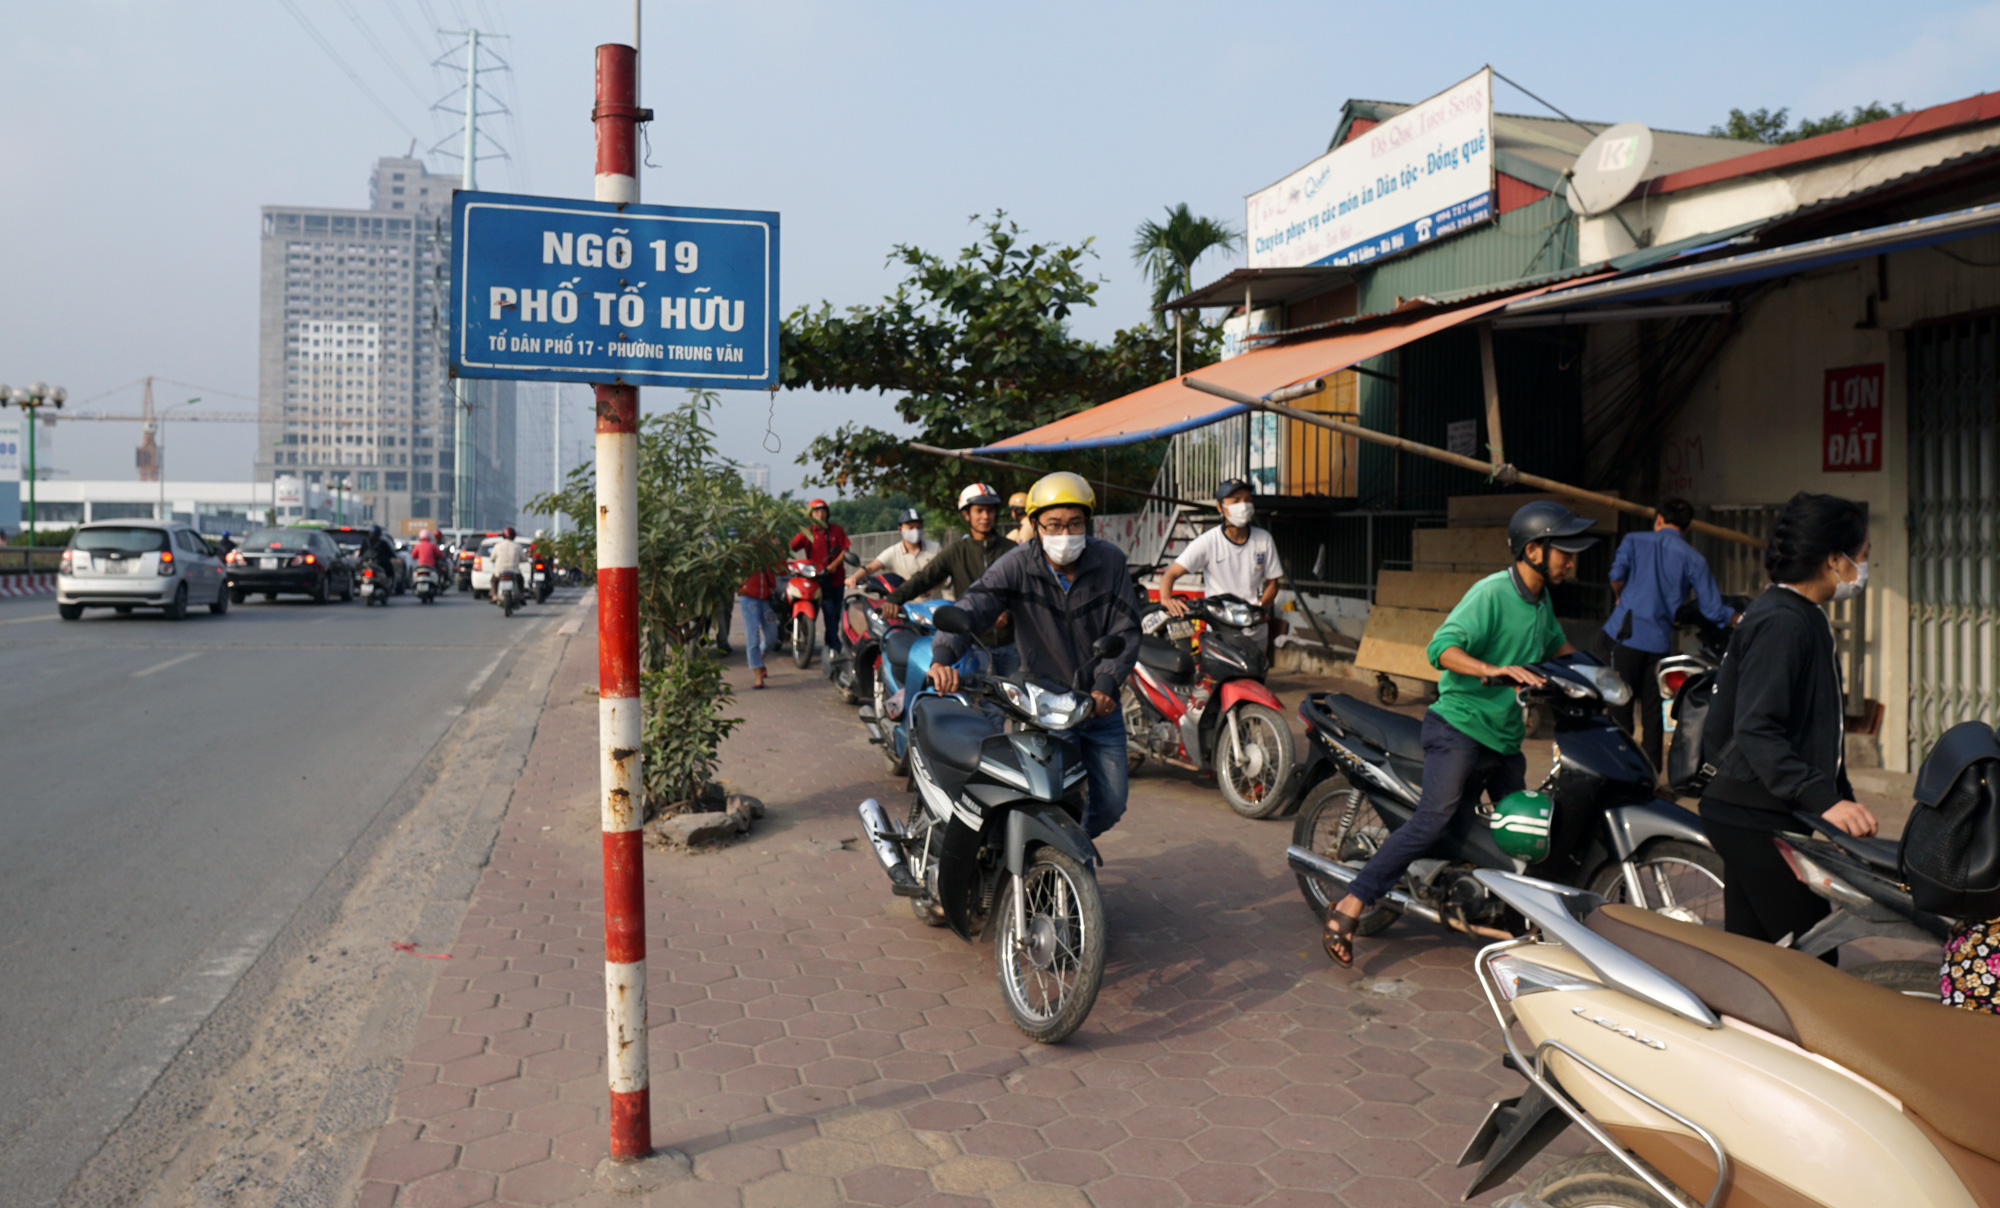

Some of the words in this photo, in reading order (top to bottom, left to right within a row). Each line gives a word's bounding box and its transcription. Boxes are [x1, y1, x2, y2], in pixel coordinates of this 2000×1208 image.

[1462, 128, 1486, 164] quê
[543, 228, 633, 269] NGÕ
[650, 240, 698, 274] 19
[490, 277, 581, 325] PHỐ
[594, 282, 647, 328] TỐ
[661, 287, 745, 332] HỮU
[489, 328, 508, 352] TỔ
[511, 336, 541, 353] DÂN
[545, 334, 574, 355] PHỐ
[577, 341, 594, 356] 17
[608, 340, 664, 360] PHƯỜNG
[668, 345, 712, 362] TRUNG
[716, 344, 744, 363] VĂN
[1830, 374, 1880, 418] LỢN
[1828, 421, 1877, 466] ĐẤT
[1571, 1006, 1667, 1050] LEAD
